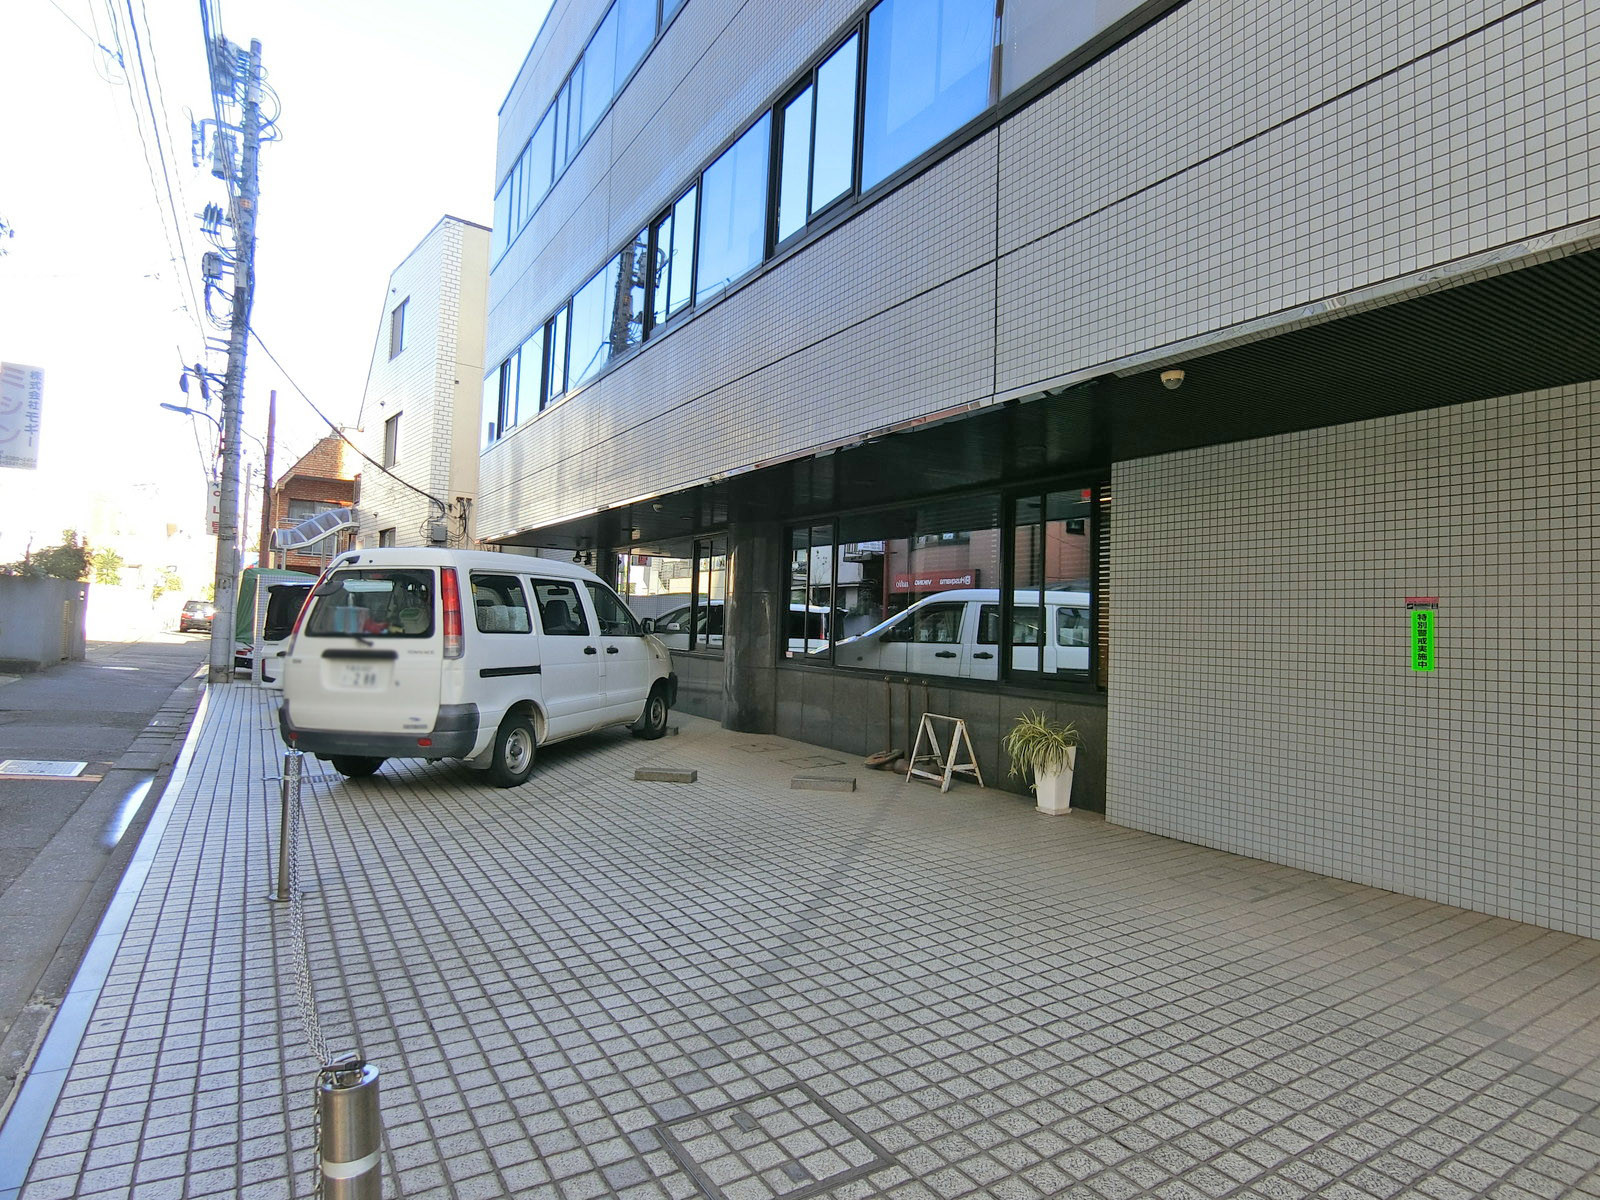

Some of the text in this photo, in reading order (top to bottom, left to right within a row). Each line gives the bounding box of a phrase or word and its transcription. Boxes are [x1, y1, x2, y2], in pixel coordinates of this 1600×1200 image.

[1417, 613, 1428, 669] 特別警戒実施中
